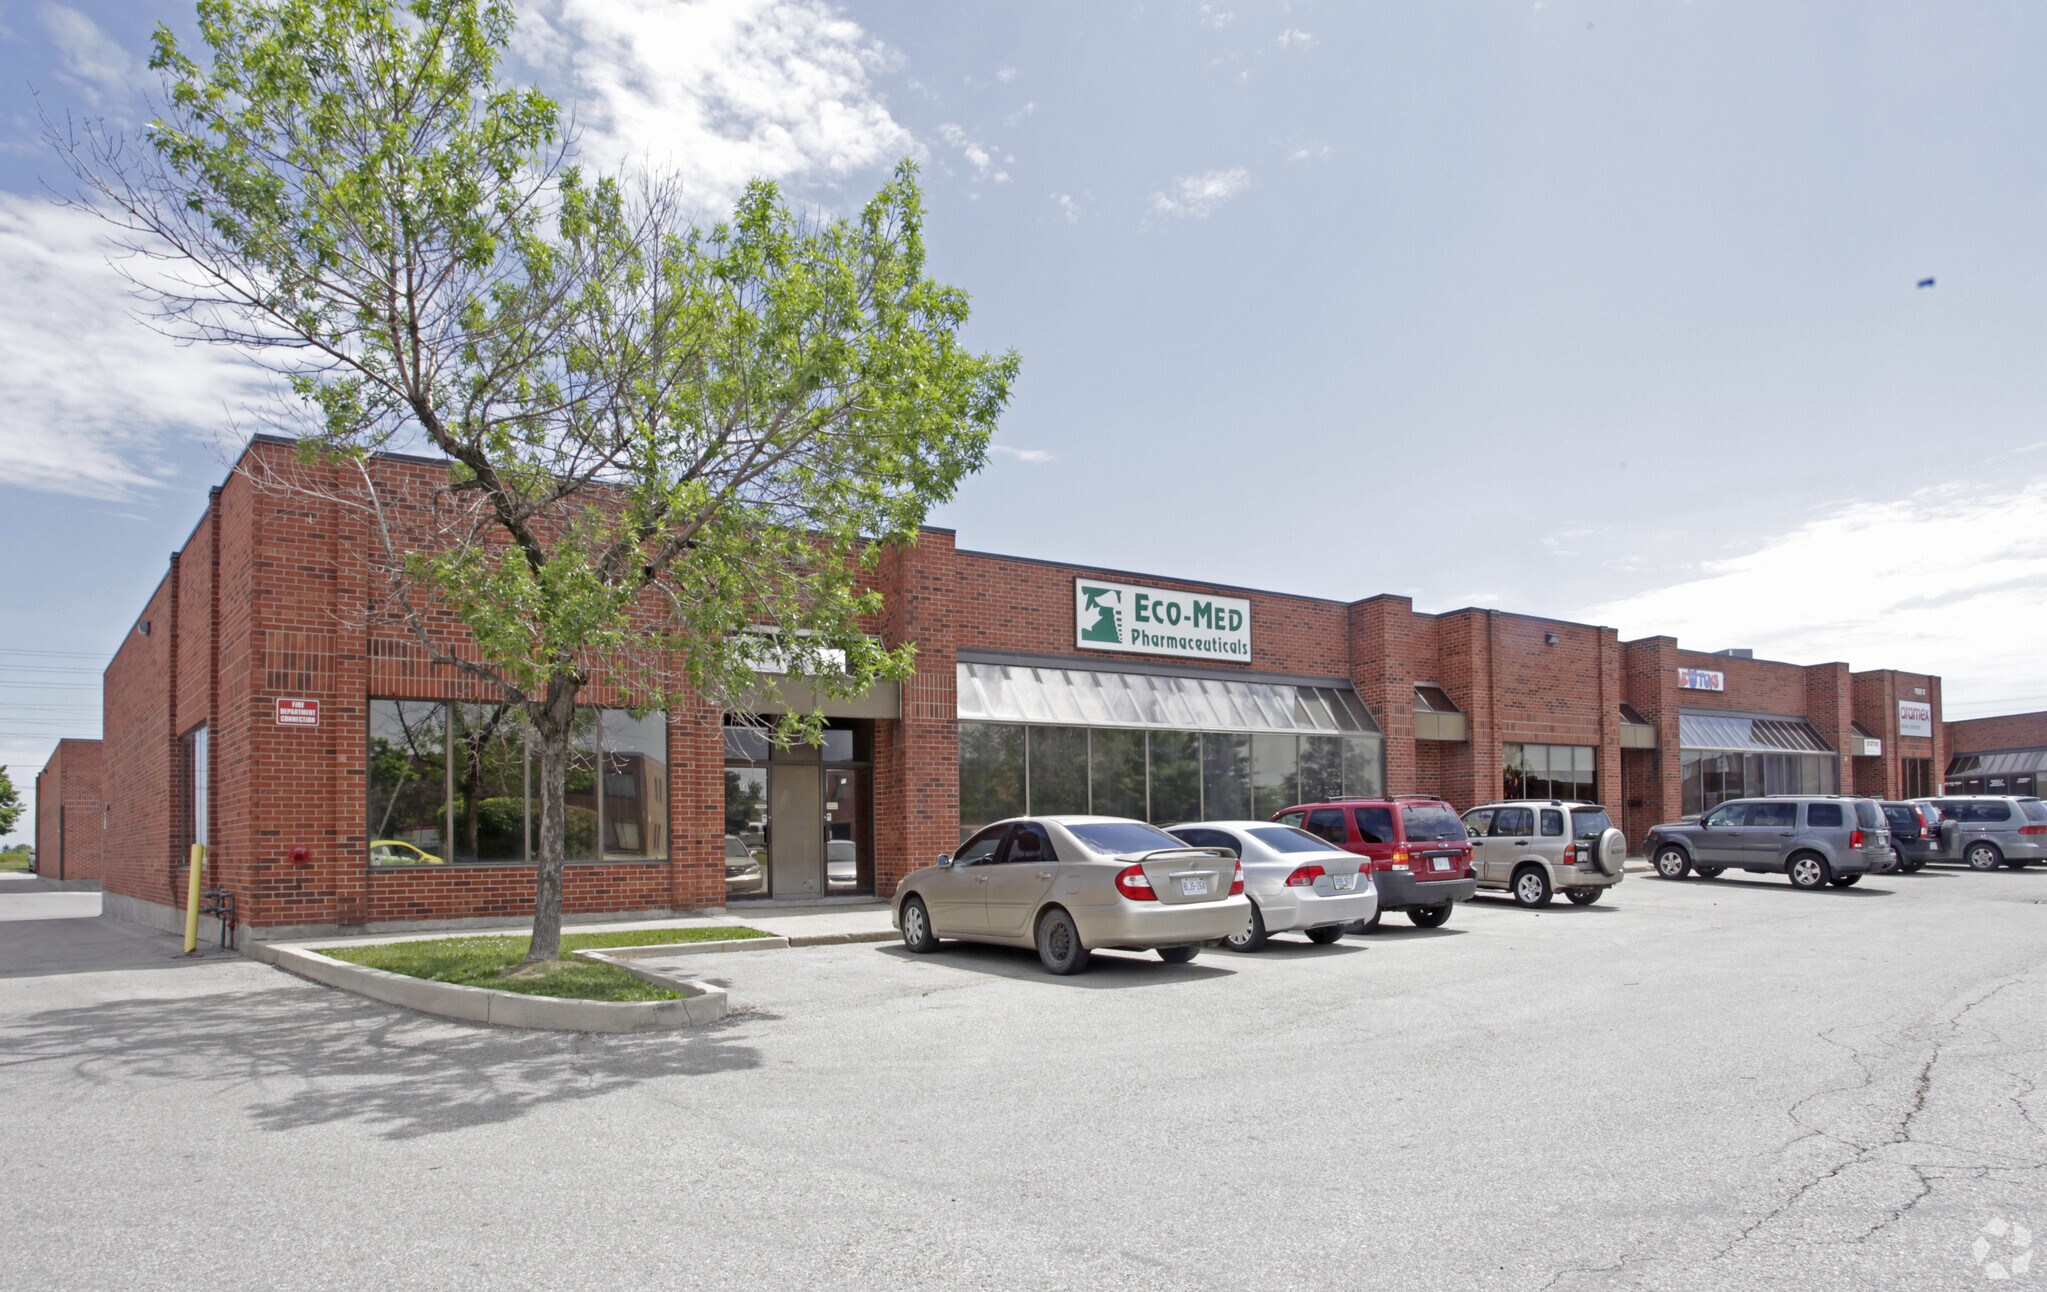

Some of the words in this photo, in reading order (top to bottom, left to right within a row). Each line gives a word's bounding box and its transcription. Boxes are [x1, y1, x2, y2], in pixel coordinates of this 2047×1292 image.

[1131, 629, 1248, 655] Pharmaceuticals
[291, 701, 305, 709] FIRE
[280, 707, 316, 717] DEPARTMENT
[1900, 706, 1930, 722] aramex
[280, 715, 316, 724] CONNECTION
